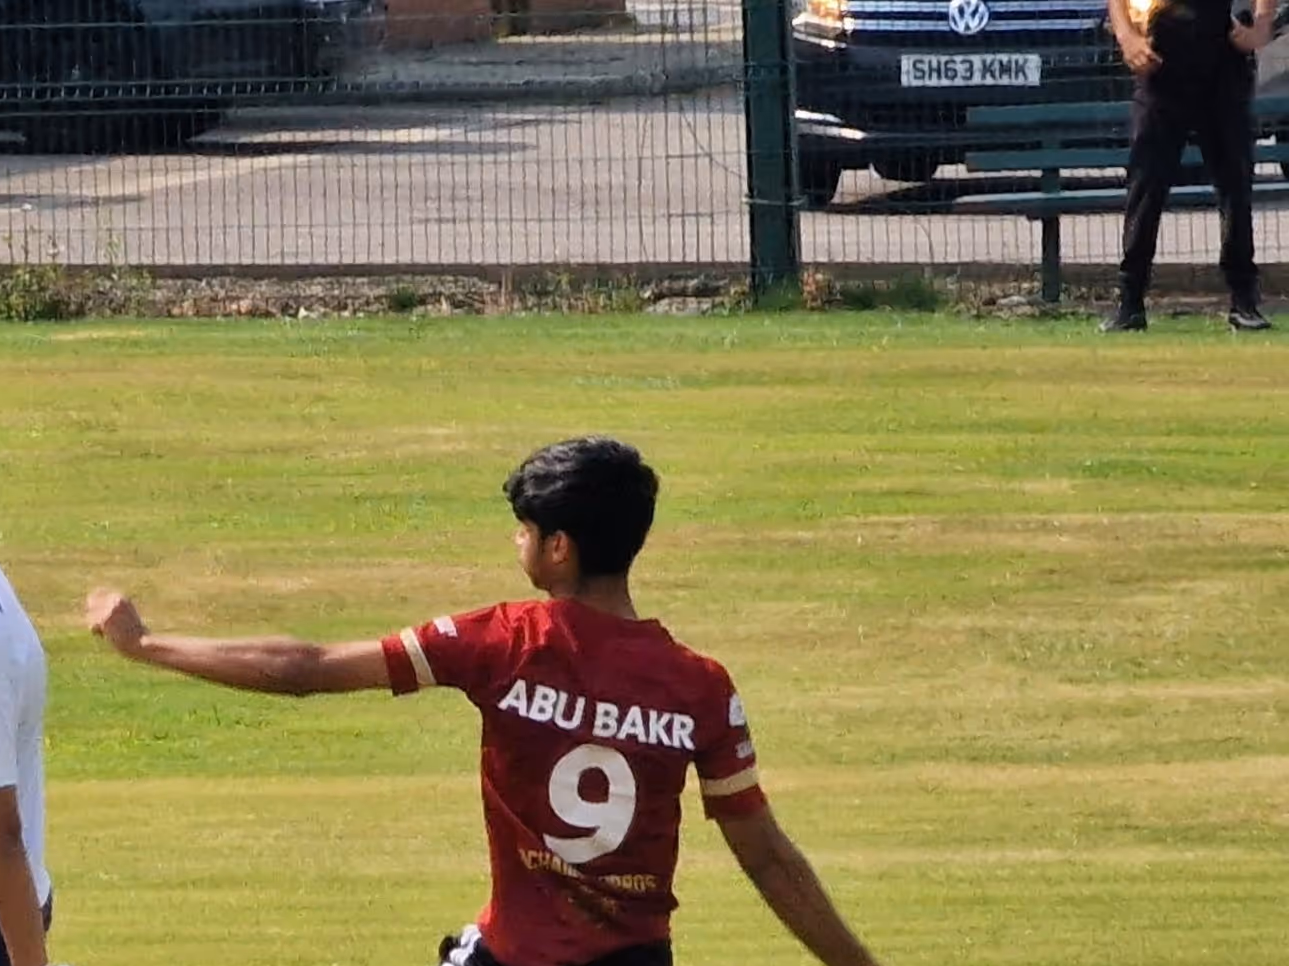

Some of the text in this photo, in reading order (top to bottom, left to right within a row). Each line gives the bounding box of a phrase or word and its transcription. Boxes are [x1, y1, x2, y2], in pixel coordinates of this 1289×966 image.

[912, 58, 974, 81] SH63
[498, 678, 696, 751] ABU BAKR
[543, 743, 636, 864] 9
